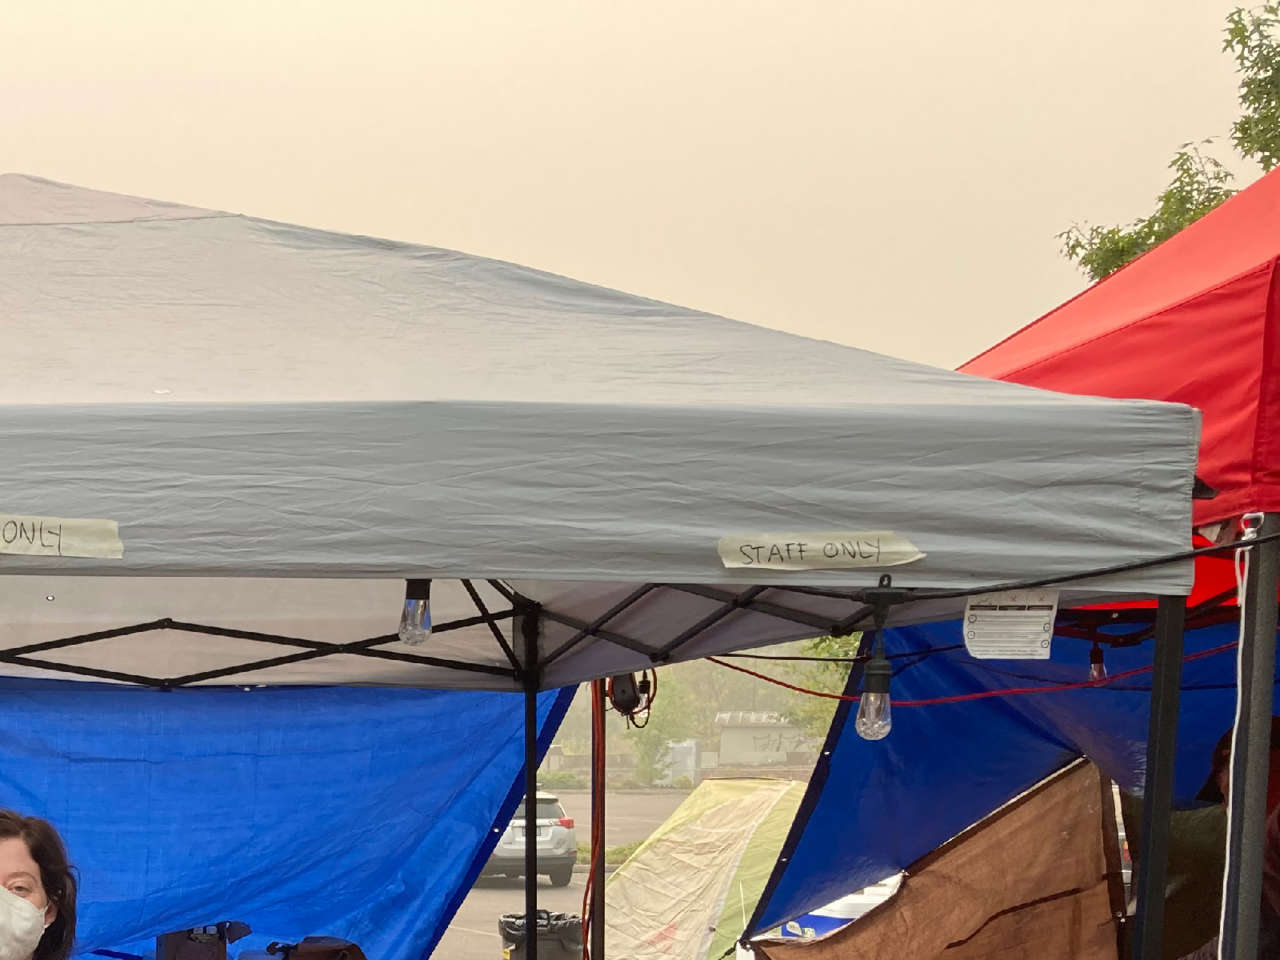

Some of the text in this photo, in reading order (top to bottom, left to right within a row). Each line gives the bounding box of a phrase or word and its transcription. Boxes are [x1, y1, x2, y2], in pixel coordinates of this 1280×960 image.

[2, 520, 62, 556] ONLY
[738, 538, 882, 564] STAFF ONLY
